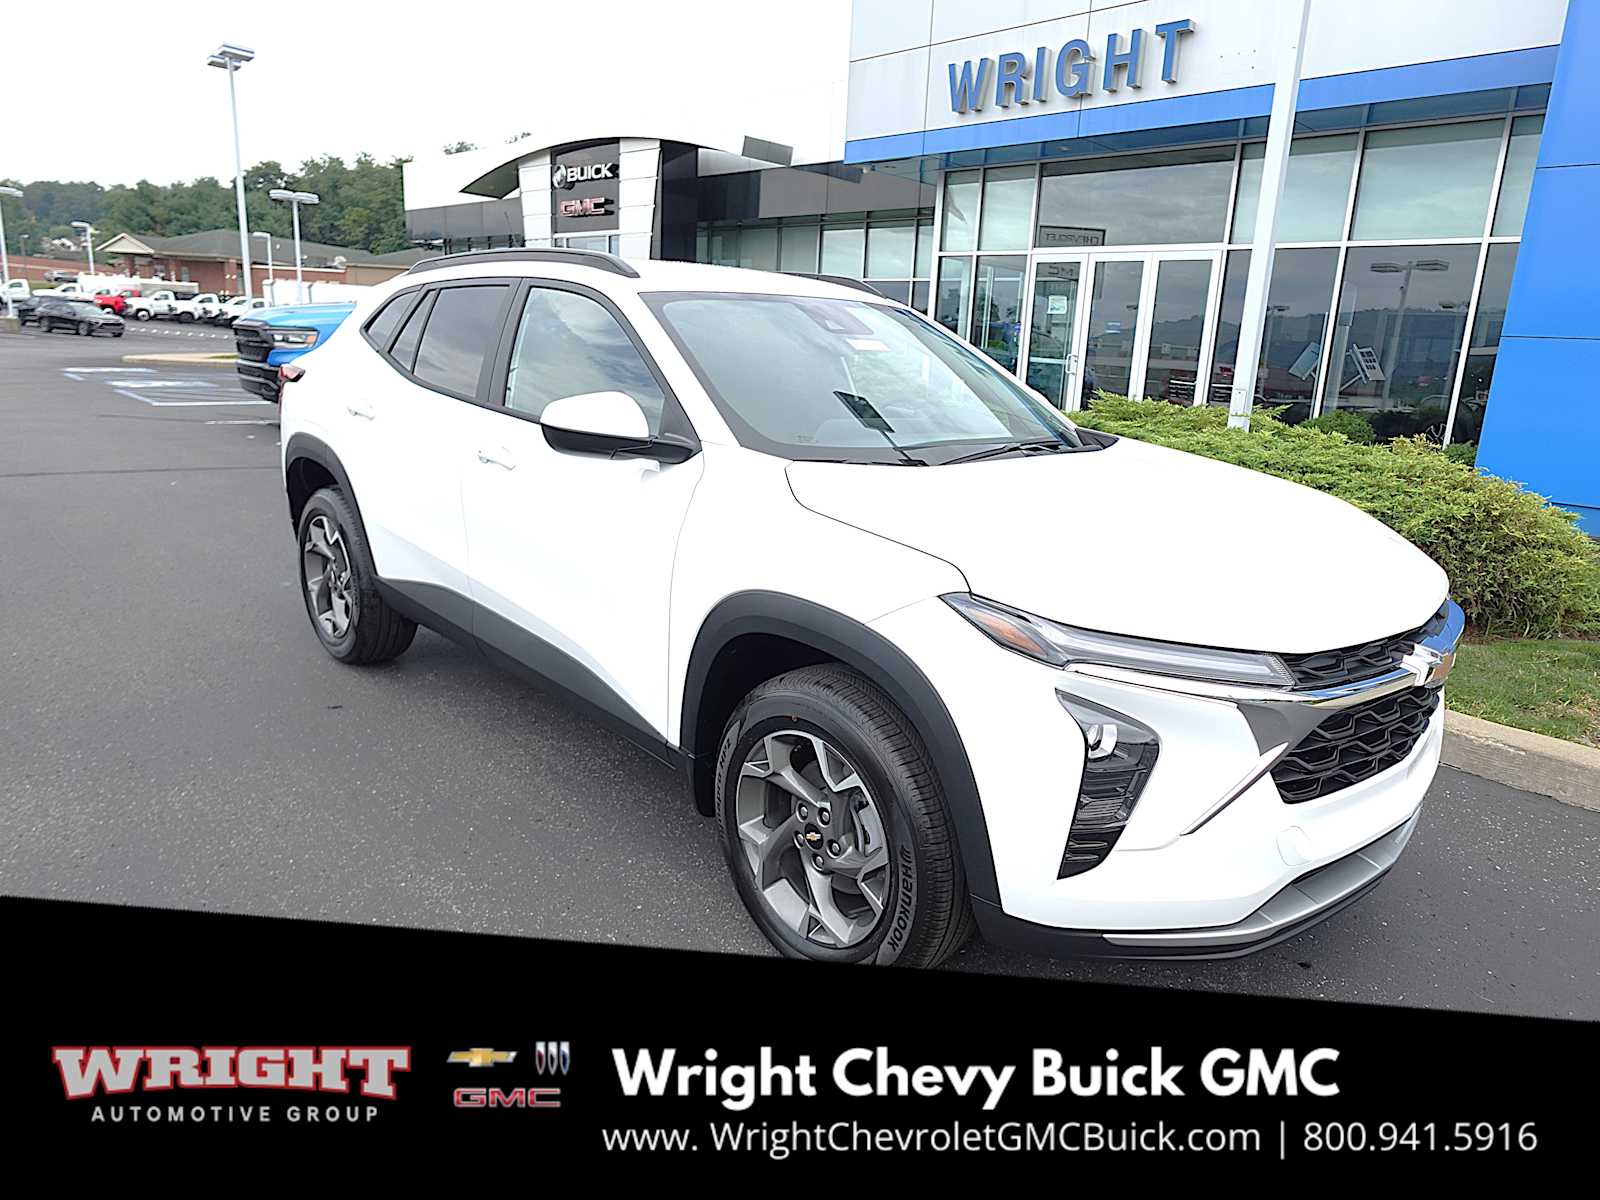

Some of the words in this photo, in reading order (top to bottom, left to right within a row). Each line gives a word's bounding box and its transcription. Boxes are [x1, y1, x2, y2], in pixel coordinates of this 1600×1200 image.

[948, 18, 1195, 113] WRIGHT
[566, 163, 614, 183] BUICK
[560, 197, 605, 217] GMC
